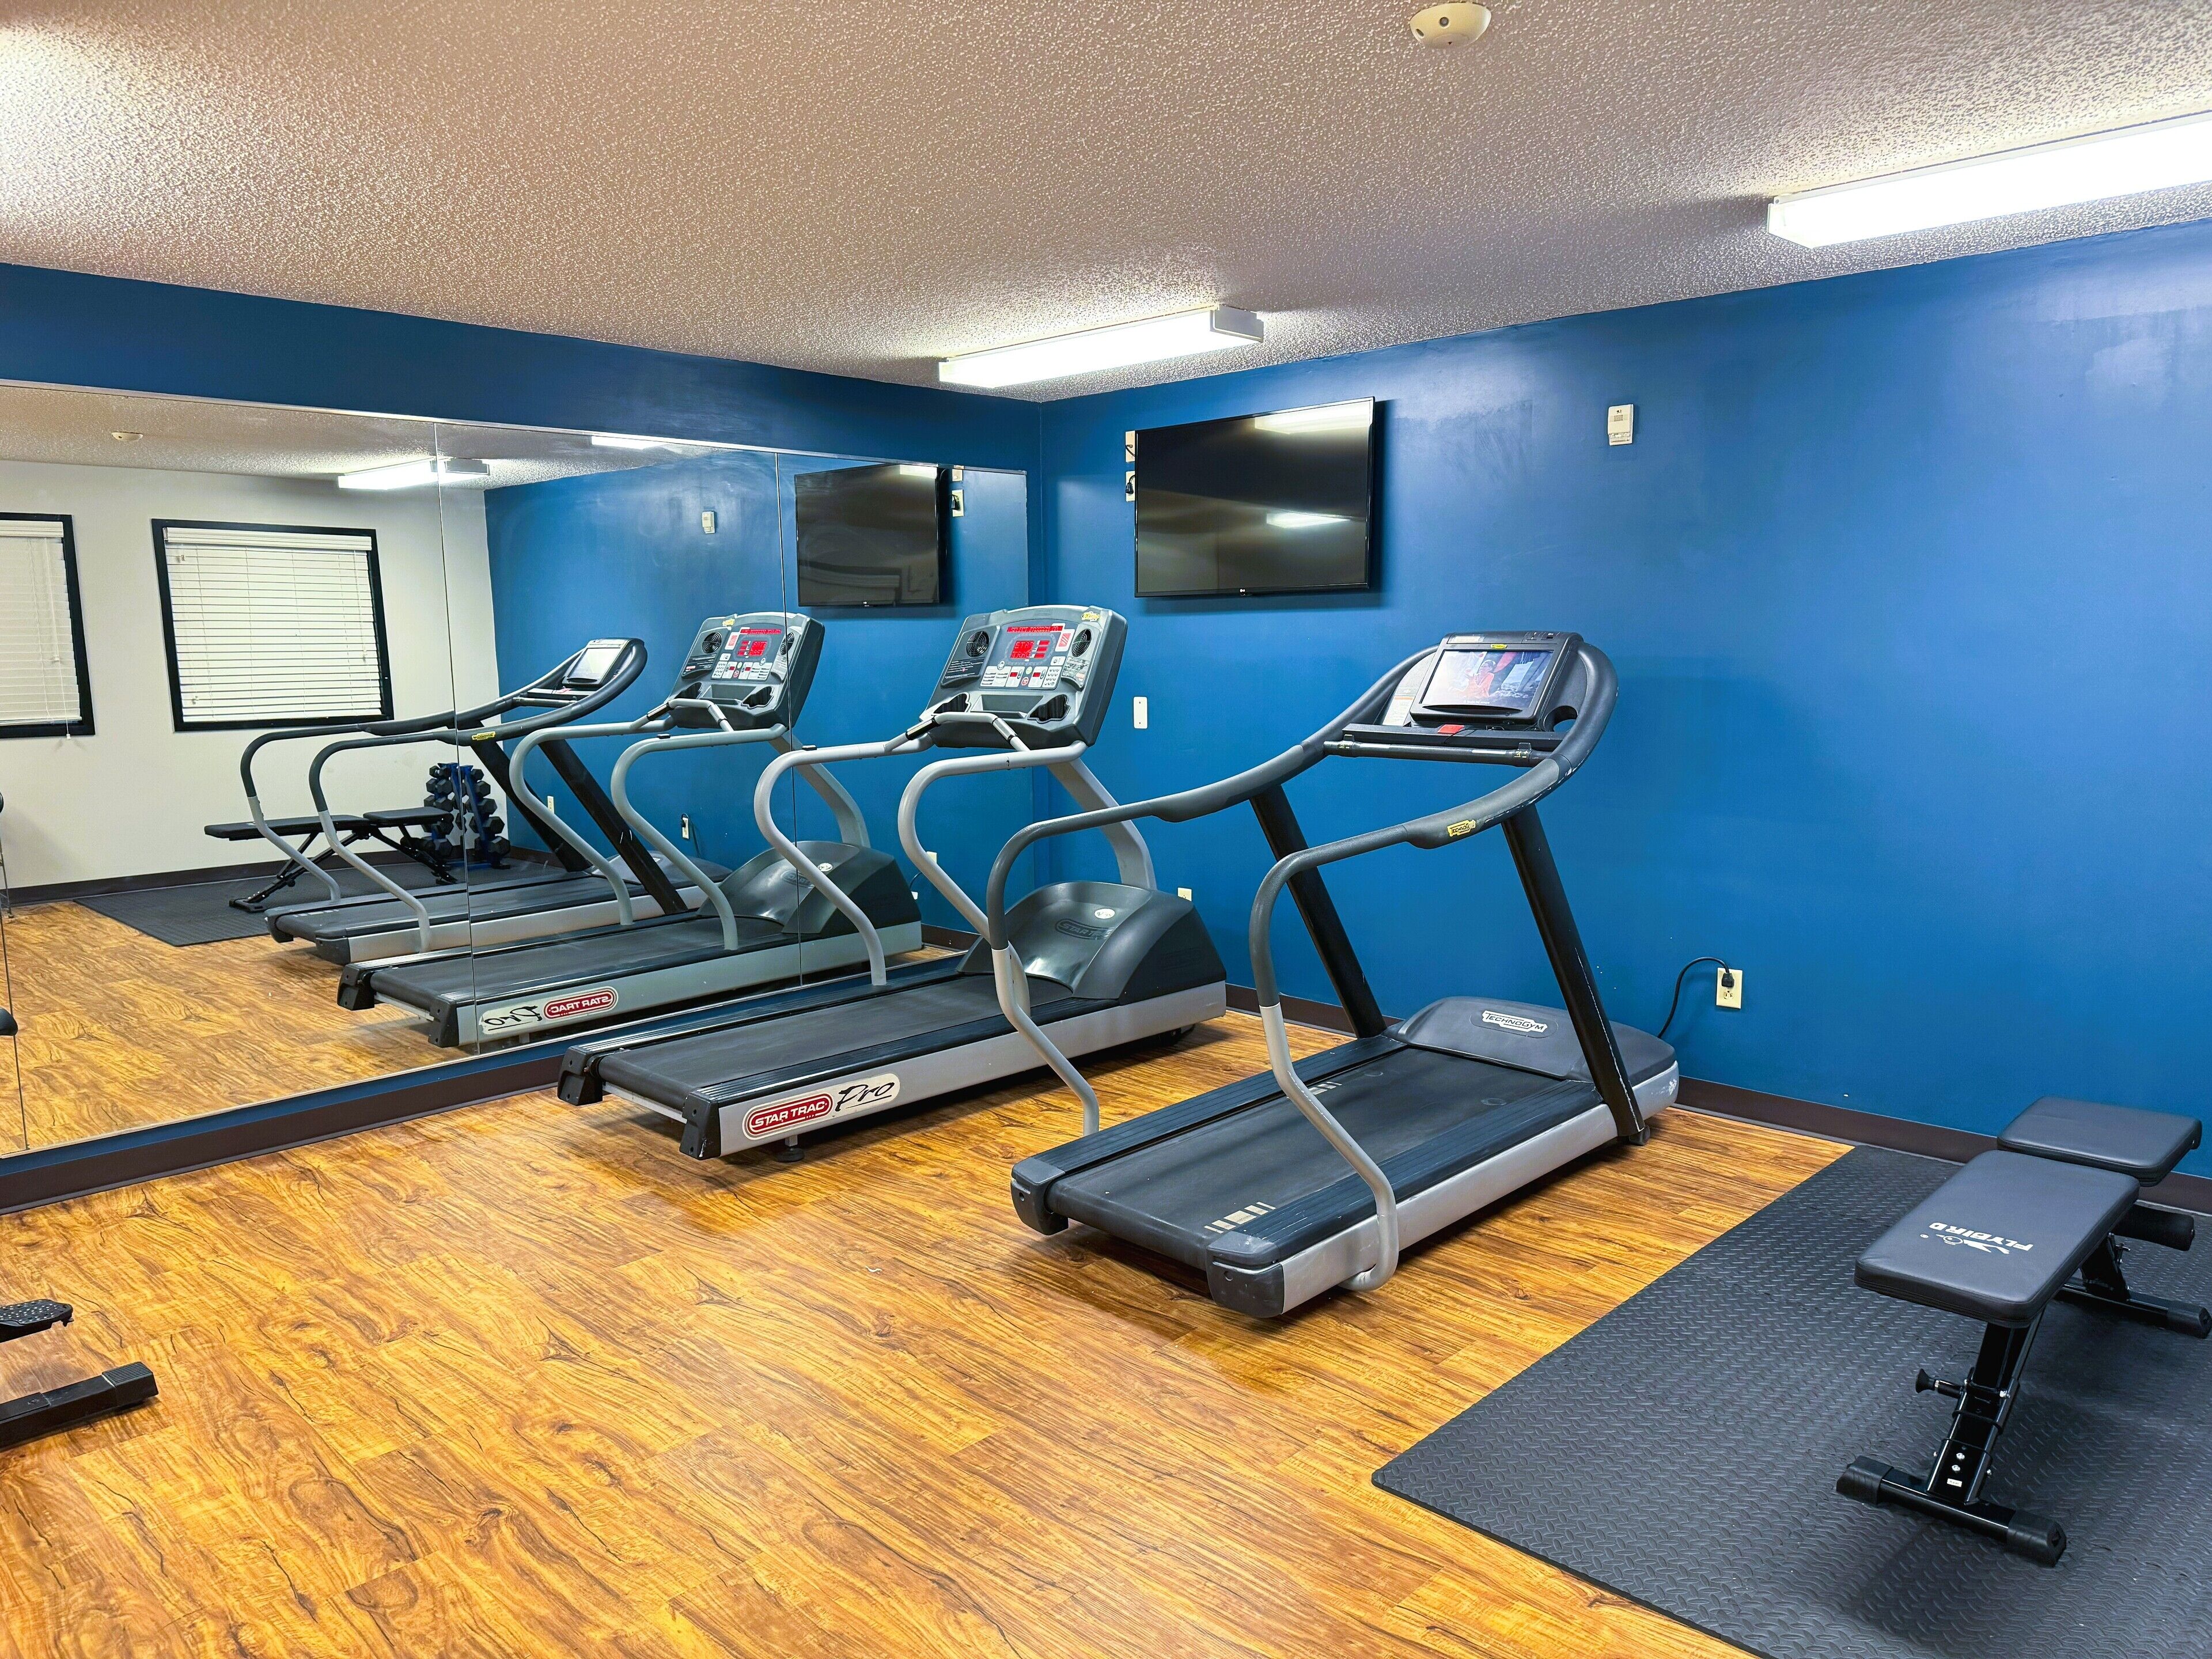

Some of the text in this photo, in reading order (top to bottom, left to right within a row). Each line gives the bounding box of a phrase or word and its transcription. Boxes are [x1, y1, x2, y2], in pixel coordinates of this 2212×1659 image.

[755, 1081, 896, 1127] STAR TRAC Pro
[1929, 1221, 2033, 1252] FLYBIRD
